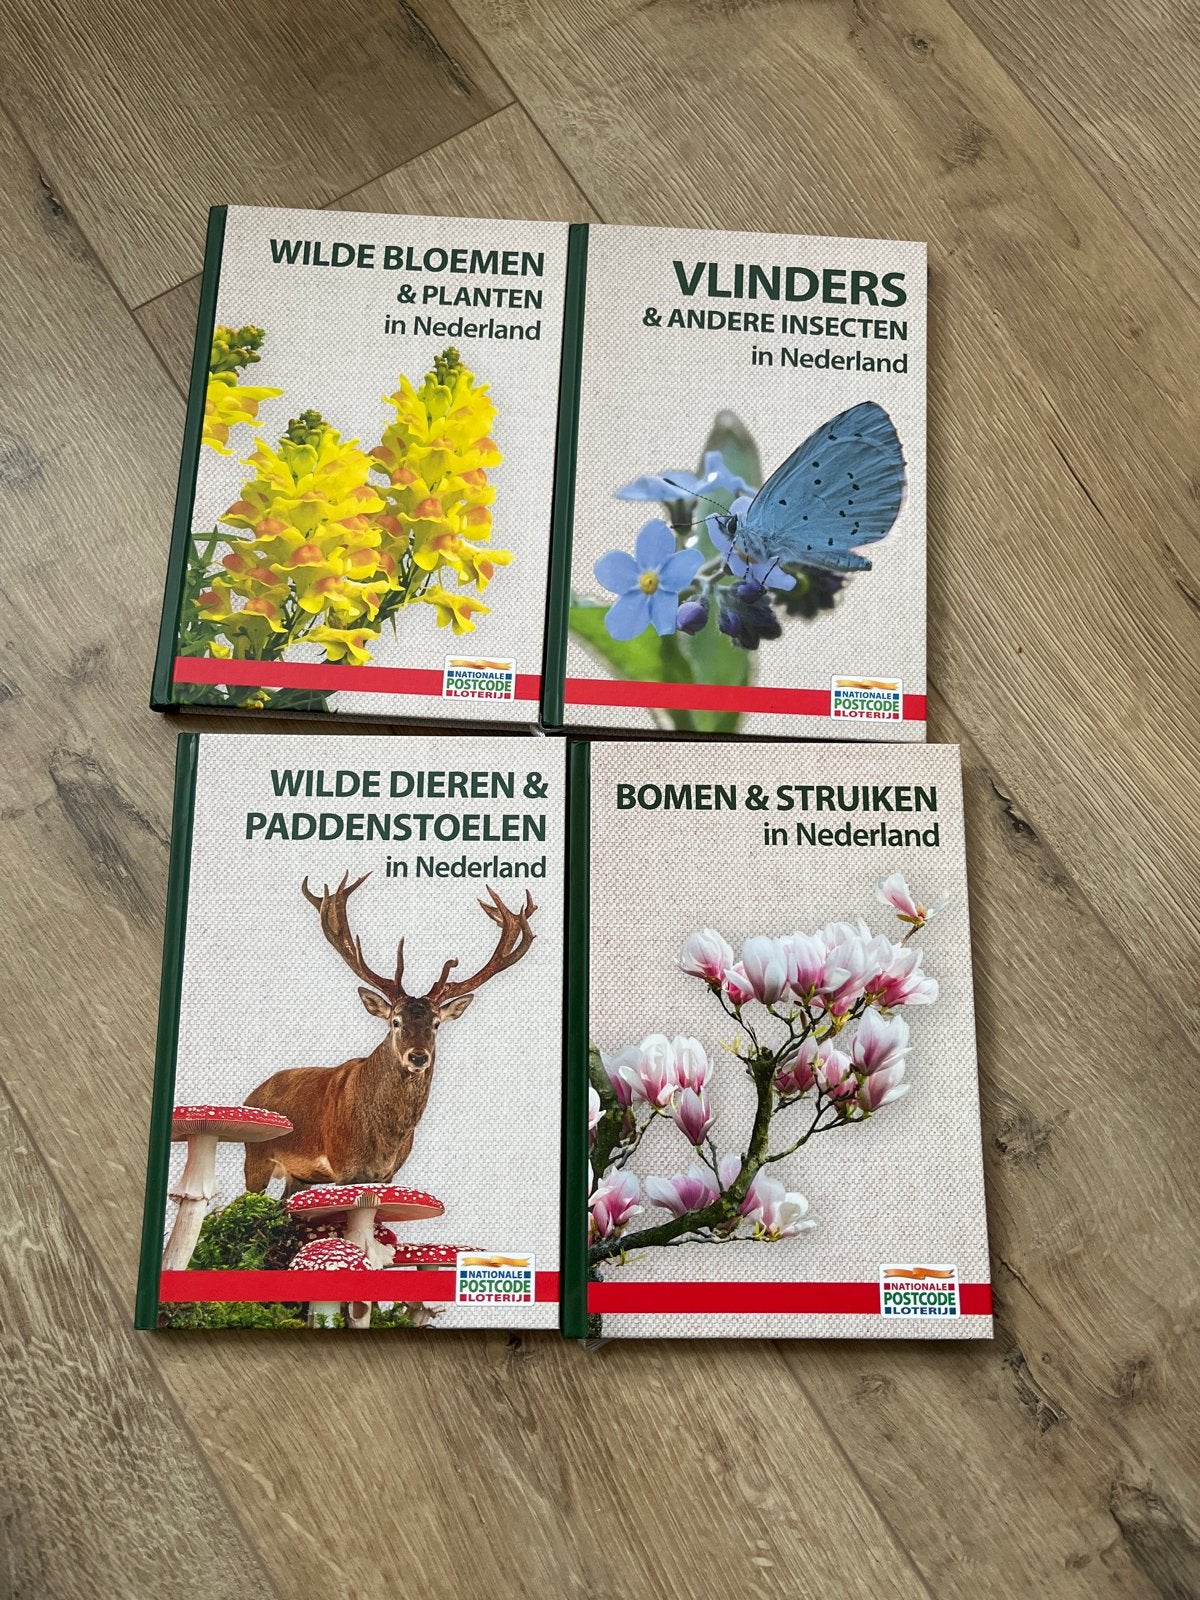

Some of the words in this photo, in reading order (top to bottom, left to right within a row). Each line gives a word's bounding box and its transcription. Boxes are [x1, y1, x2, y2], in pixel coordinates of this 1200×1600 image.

[270, 239, 375, 268] WILDE
[384, 246, 544, 276] BLOEMEN
[673, 261, 906, 307] VLINDERS
[397, 284, 416, 304] &
[423, 286, 542, 309] PLANTEN
[385, 315, 405, 334] in
[414, 316, 541, 340] Nederland
[643, 308, 662, 327] &
[667, 309, 774, 332] ANDERE
[782, 315, 907, 340] INSECTEN
[752, 346, 772, 365] in
[781, 348, 907, 373] Nederland
[455, 671, 505, 680] NATIONALE
[446, 678, 512, 692] POSTCODE
[454, 690, 503, 699] LOTERIJ
[842, 691, 892, 700] NATIONALE
[834, 698, 899, 712] POSTCODE
[842, 710, 892, 719] LOTERIJ
[271, 770, 380, 797] WILDE
[390, 771, 514, 798] DIEREN
[523, 772, 548, 798] &
[617, 784, 736, 810] BOMEN
[745, 785, 769, 810] &
[777, 785, 937, 811] STRUIKEN
[246, 813, 545, 841] PADDENSTOELEN
[764, 822, 787, 845] in
[797, 822, 939, 847] Nederland
[387, 856, 407, 877] in
[416, 855, 546, 878] Nederland
[468, 1270, 523, 1279] NATIONALE
[459, 1279, 531, 1293] POSTCODE
[891, 1283, 947, 1291] NATIONALE
[468, 1293, 522, 1302] LOTERIJ
[883, 1291, 956, 1306] POSTCODE
[893, 1306, 948, 1315] LOTERIJ
